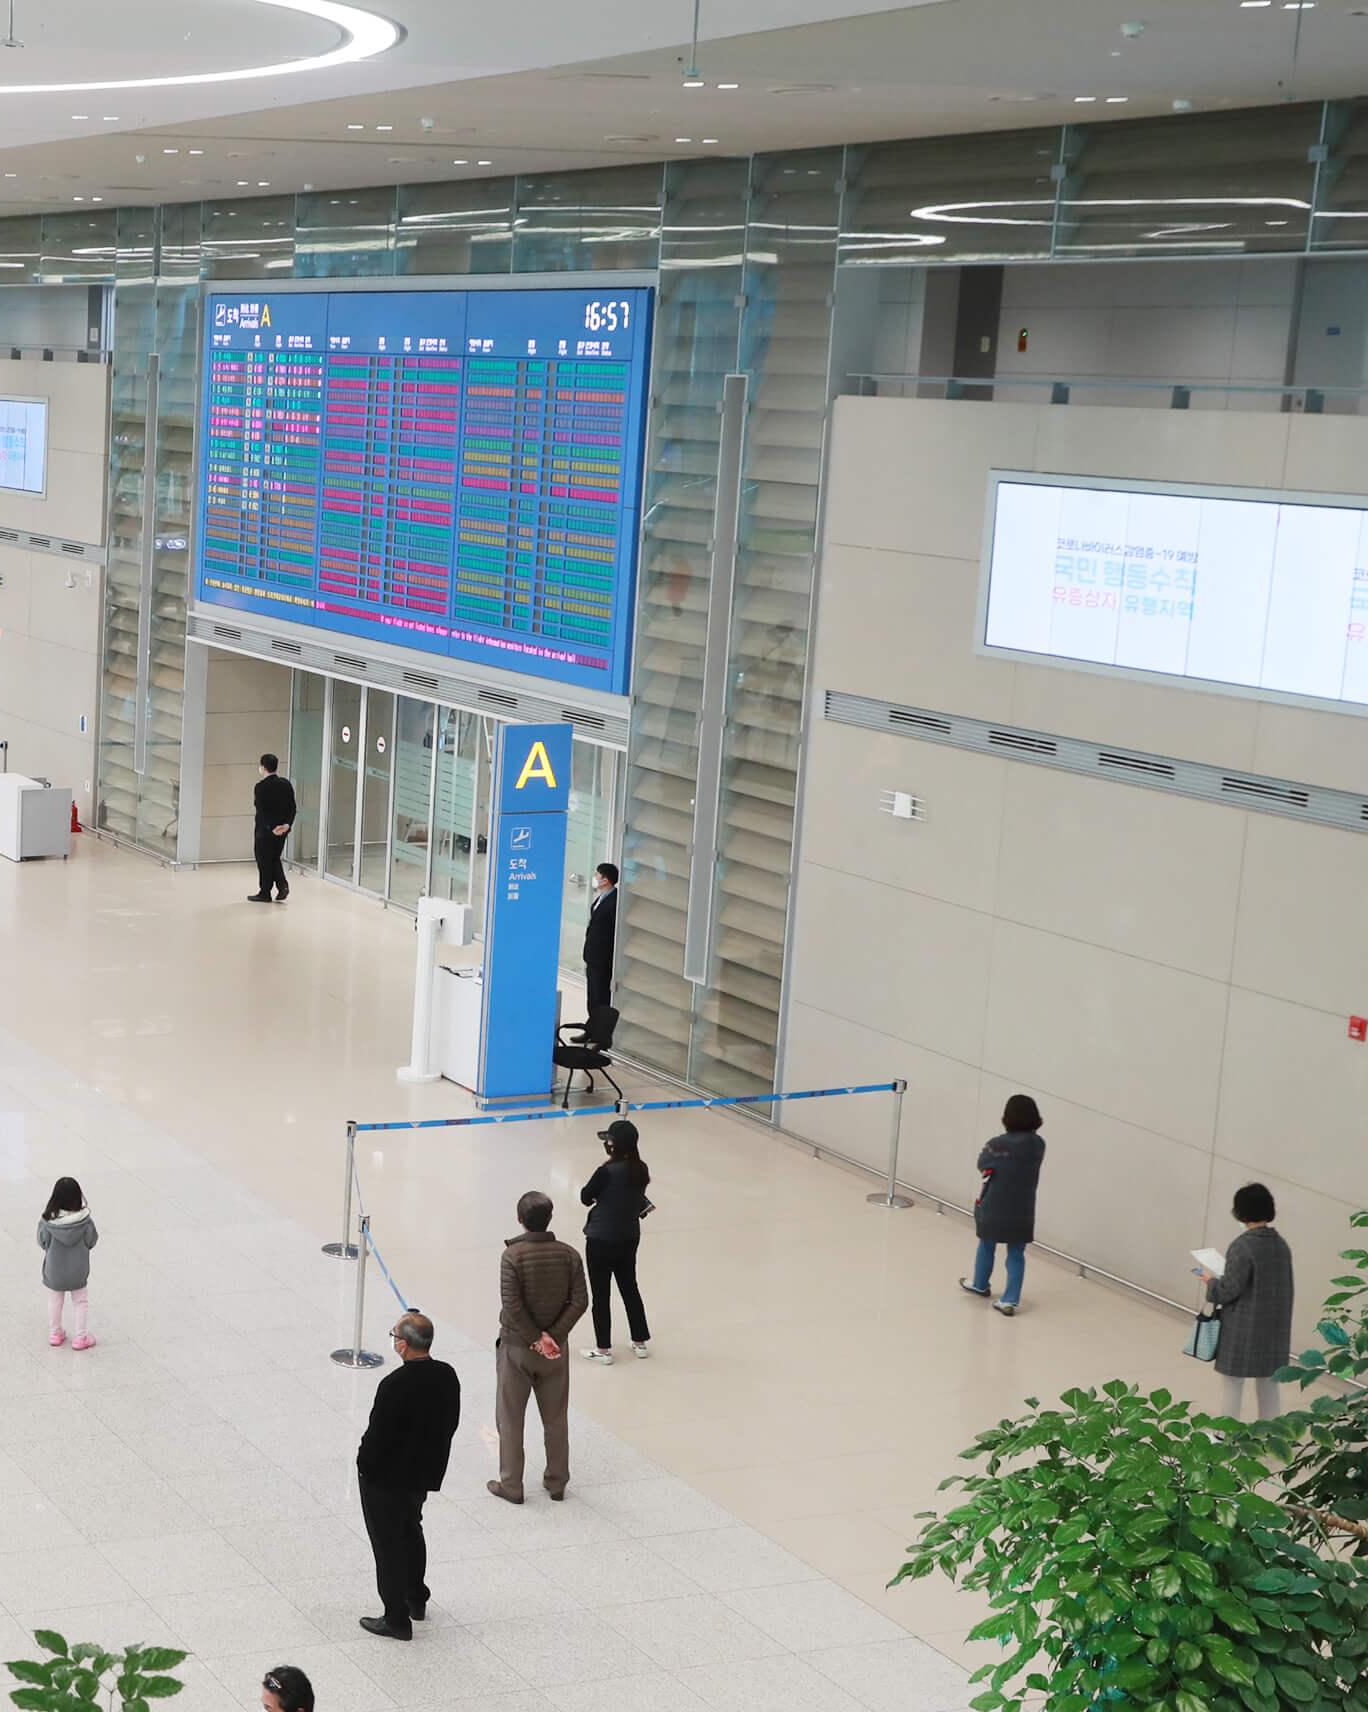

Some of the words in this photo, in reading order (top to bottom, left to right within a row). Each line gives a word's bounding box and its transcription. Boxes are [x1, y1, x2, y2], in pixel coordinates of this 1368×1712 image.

[260, 304, 272, 327] A
[585, 301, 630, 331] 16:57
[1055, 554, 1097, 585] 국민
[1052, 585, 1118, 612] 유증상자
[515, 741, 558, 789] A
[508, 871, 537, 881] Arrivals
[509, 858, 527, 870] 도착
